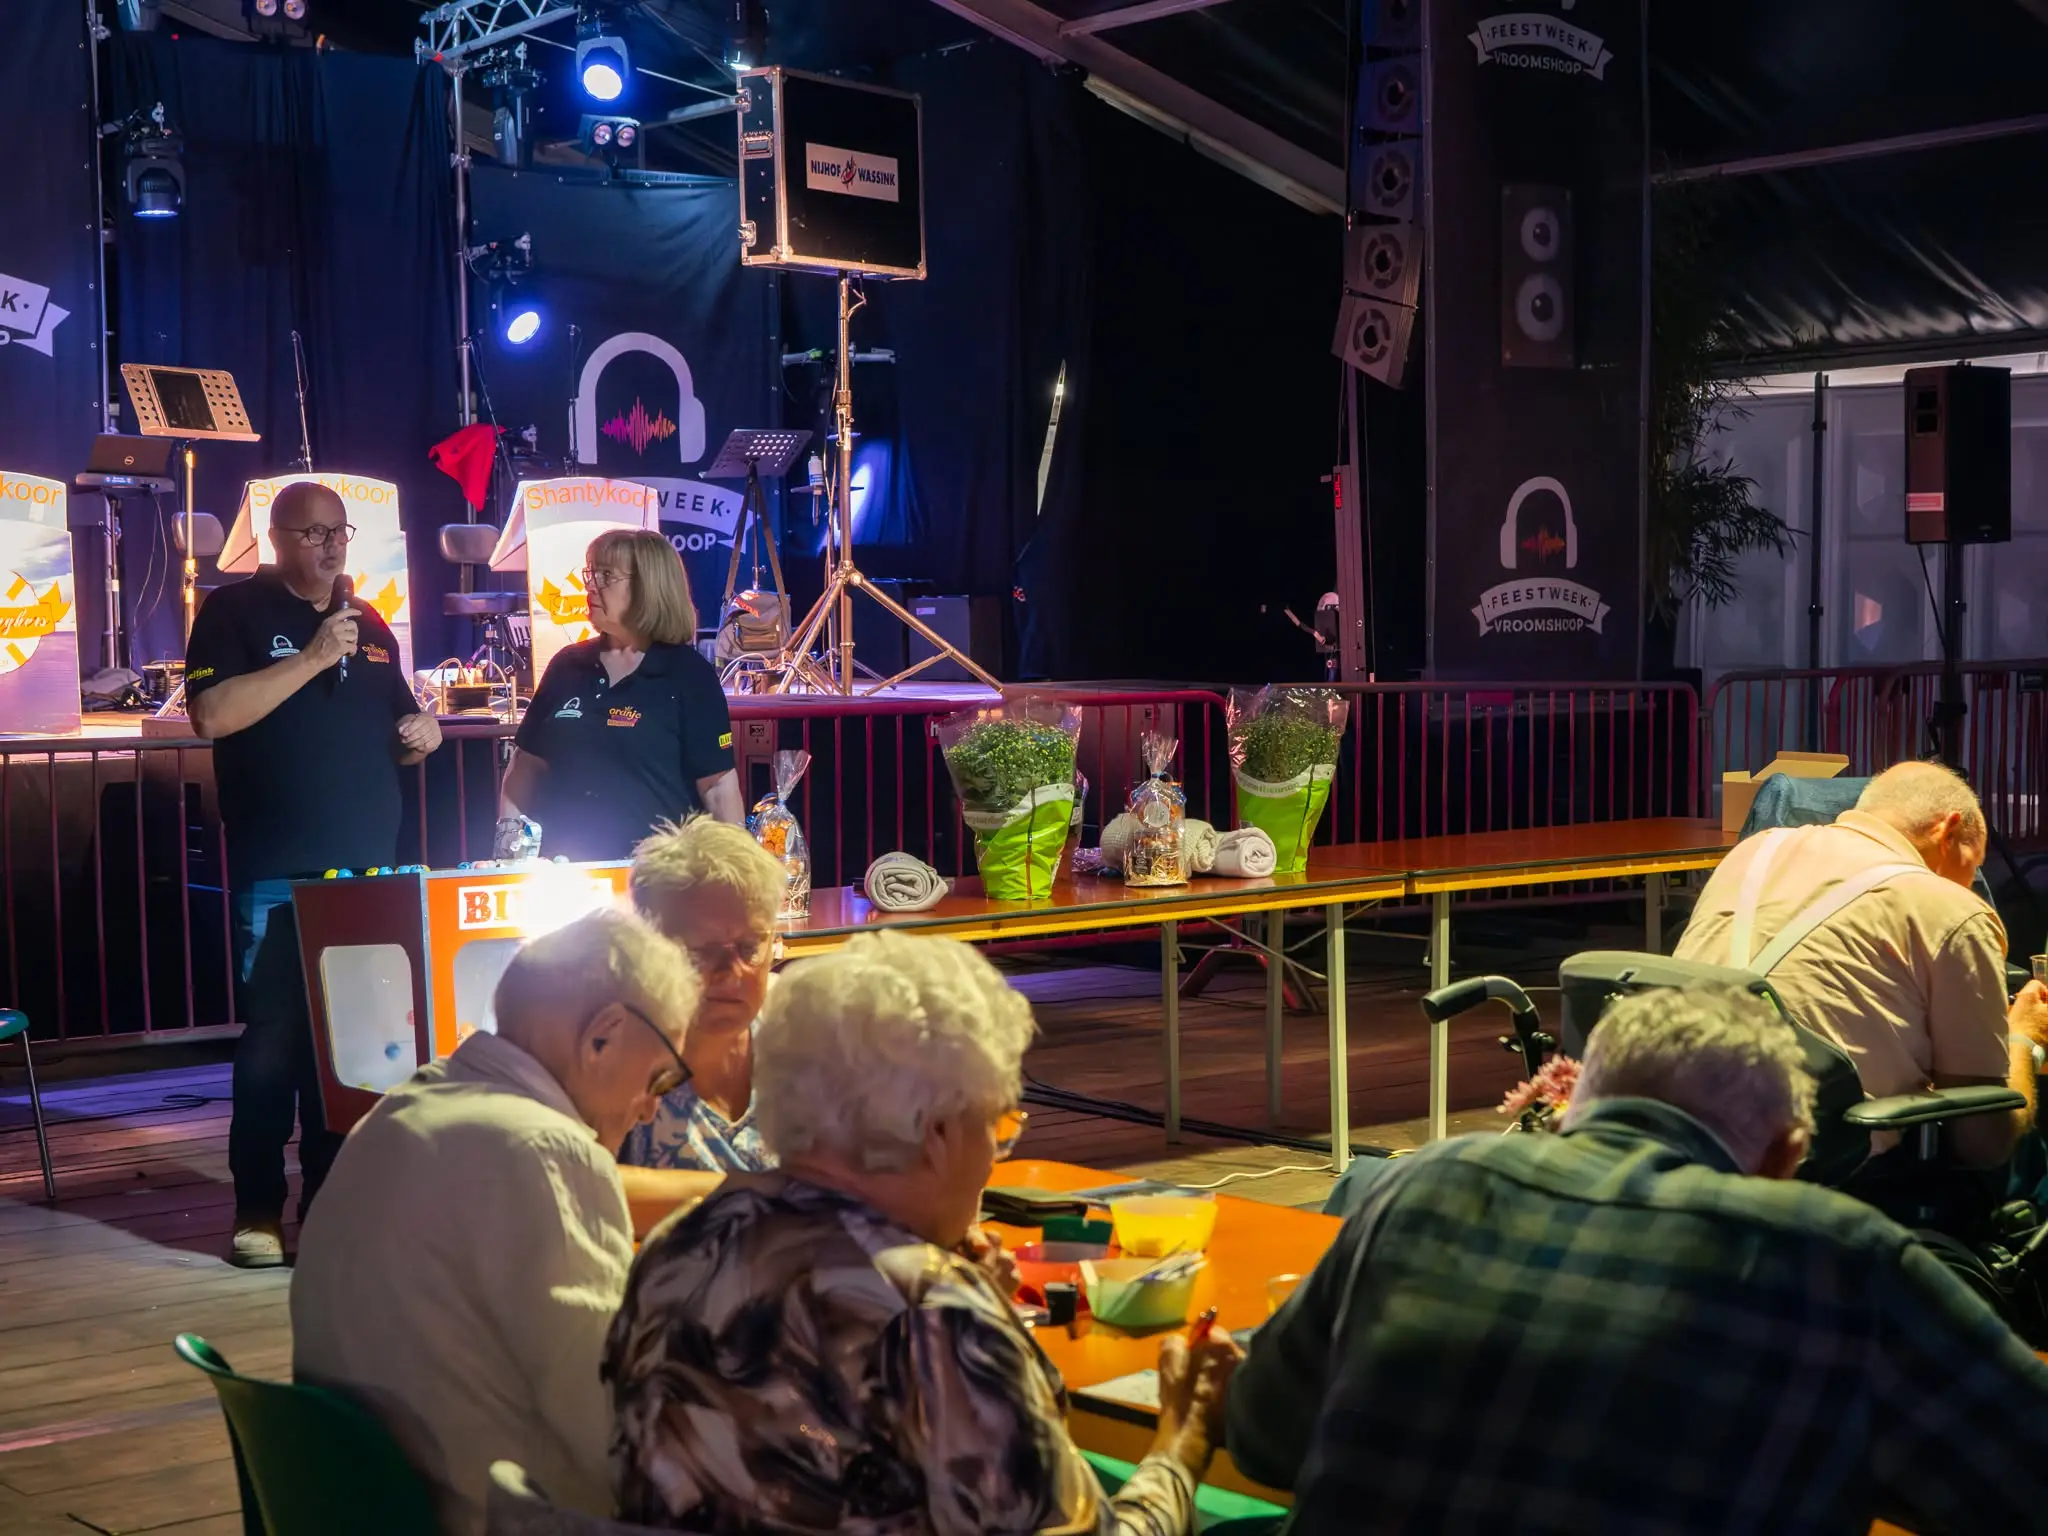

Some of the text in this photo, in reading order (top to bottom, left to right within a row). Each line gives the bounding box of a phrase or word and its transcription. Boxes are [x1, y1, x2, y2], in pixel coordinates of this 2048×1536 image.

[1494, 51, 1581, 75] VROOMSHOOP
[811, 160, 896, 187] NIJHOF WASSINK
[0, 474, 62, 506] koor
[526, 480, 655, 510] Shantykoor
[1494, 618, 1584, 633] VROOMSHOOP
